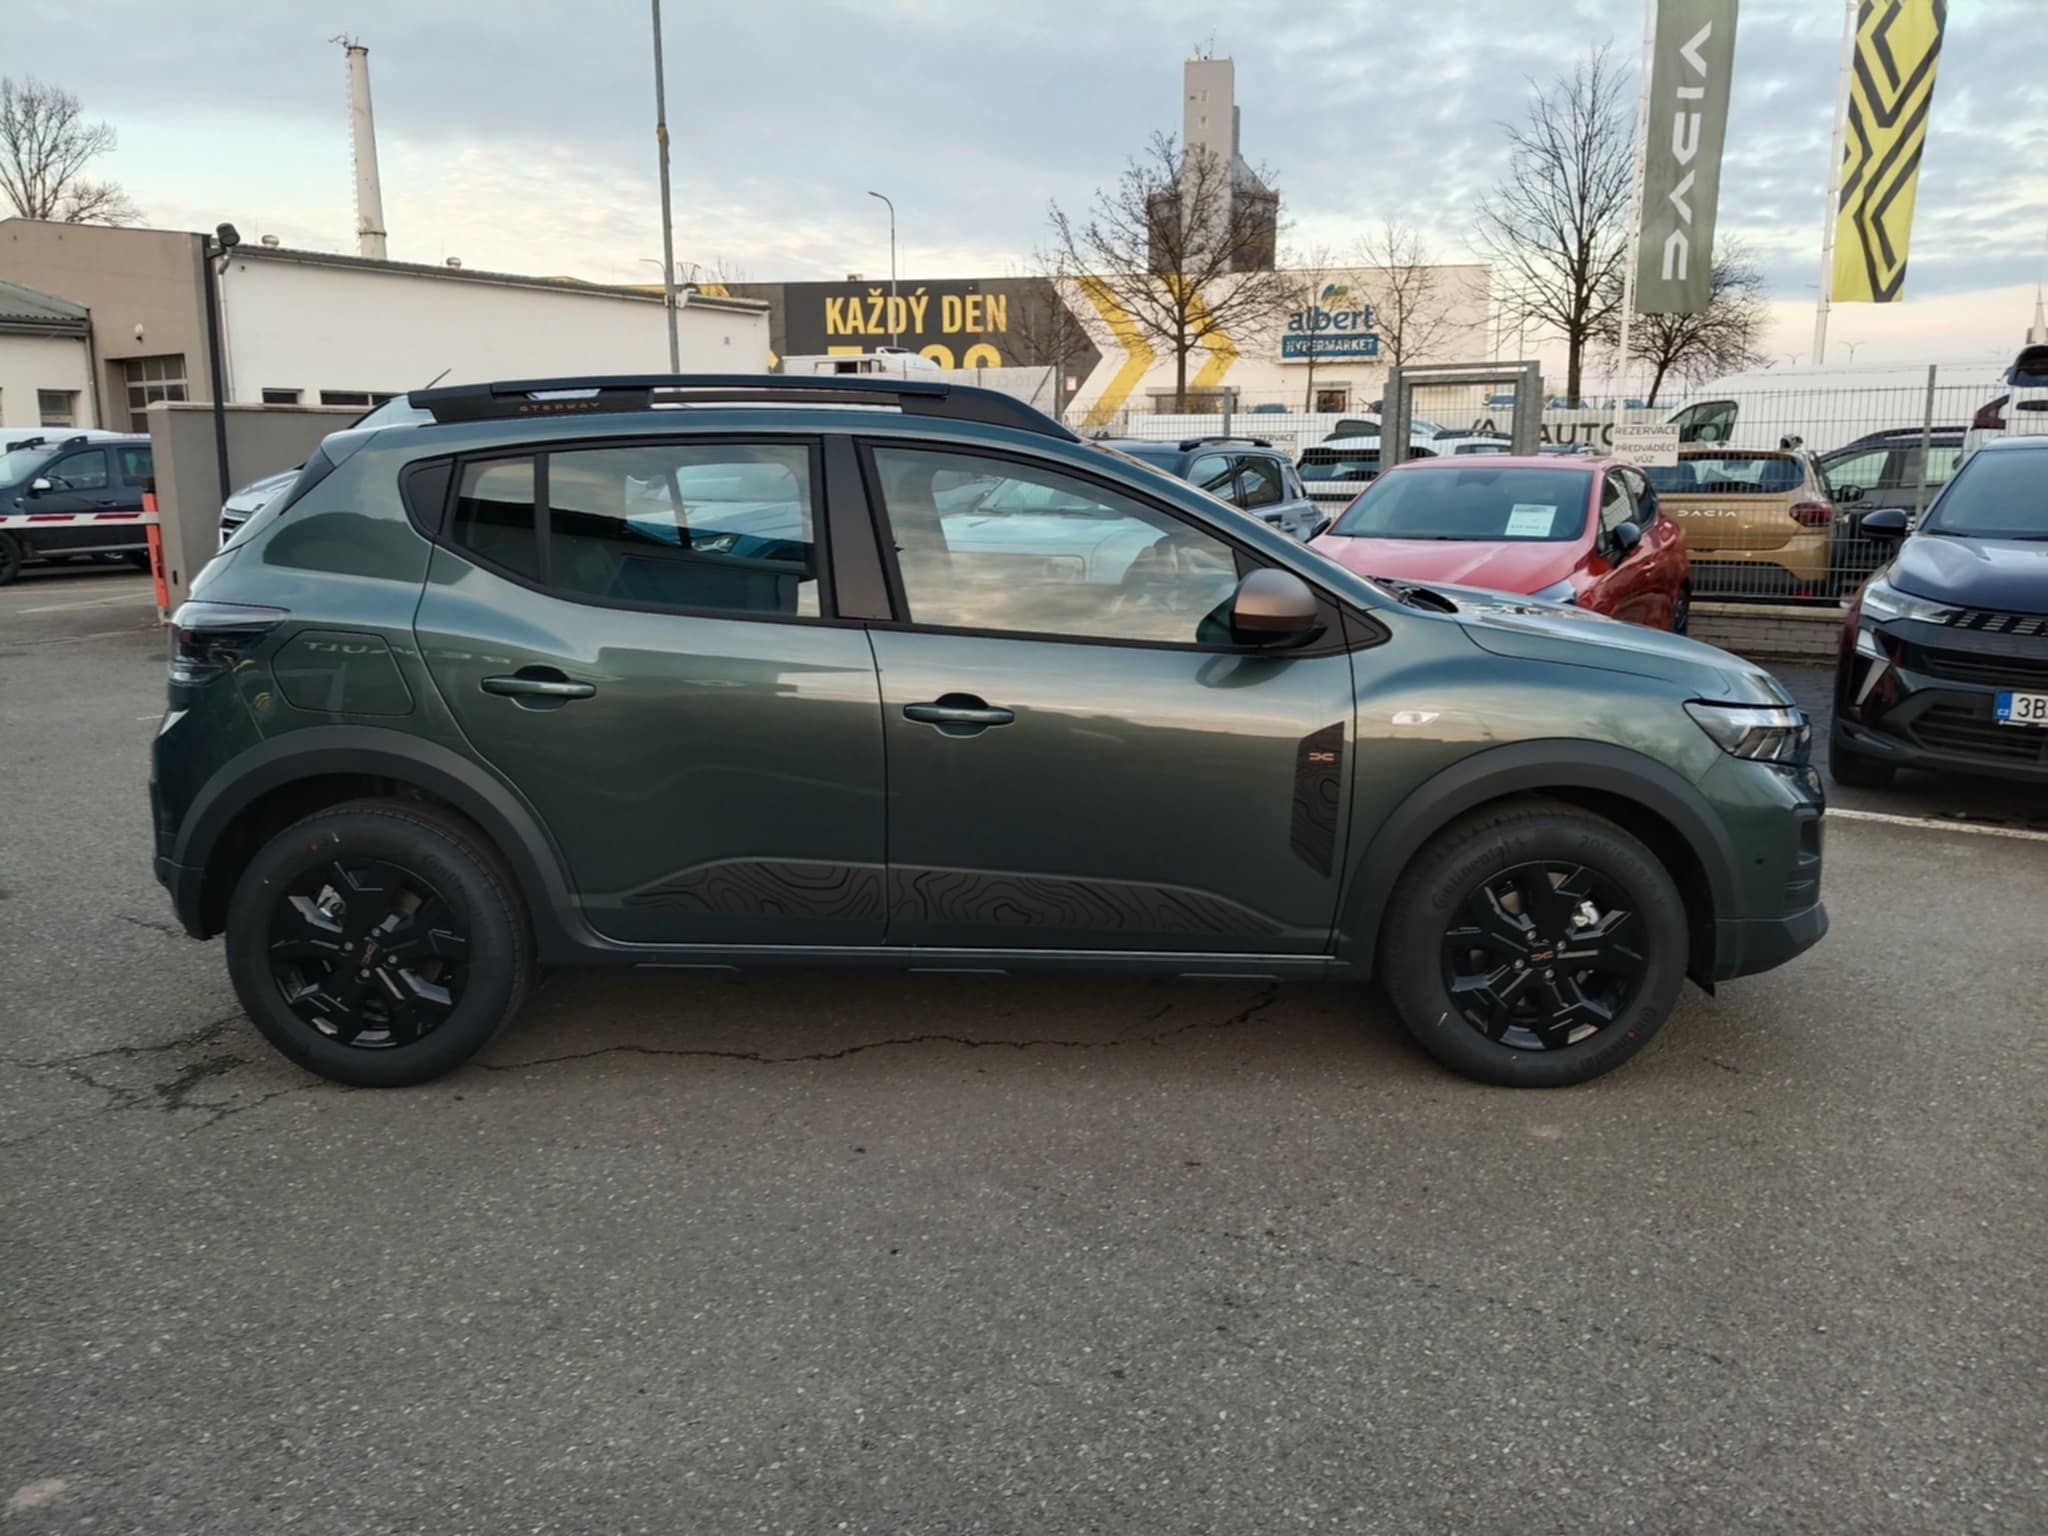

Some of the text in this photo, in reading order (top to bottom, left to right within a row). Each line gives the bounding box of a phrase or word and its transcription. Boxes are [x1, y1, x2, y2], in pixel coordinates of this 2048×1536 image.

[1662, 20, 1712, 281] DACIA
[825, 286, 1007, 335] KAŽDÝ DEN
[1288, 304, 1375, 331] albert
[1286, 338, 1375, 353] HYPERMARKET
[1615, 426, 1678, 435] REZERVACE
[1677, 509, 1737, 518] DACIA
